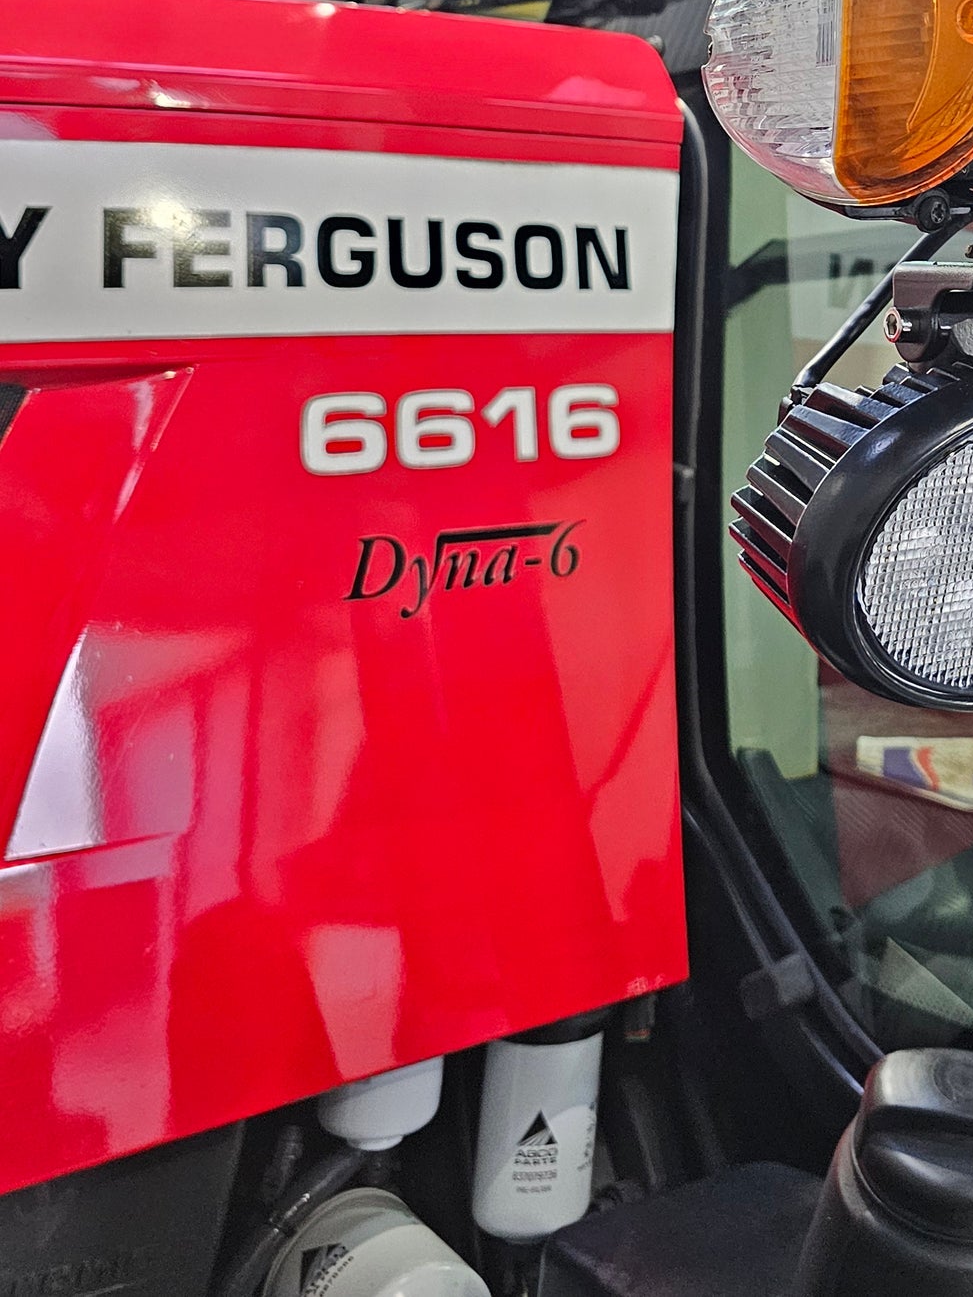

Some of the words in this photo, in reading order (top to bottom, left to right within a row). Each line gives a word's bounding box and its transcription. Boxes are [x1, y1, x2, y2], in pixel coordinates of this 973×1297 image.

[102, 206, 632, 291] FERGUSON
[301, 383, 621, 476] 6616
[342, 519, 587, 619] Dyna-6
